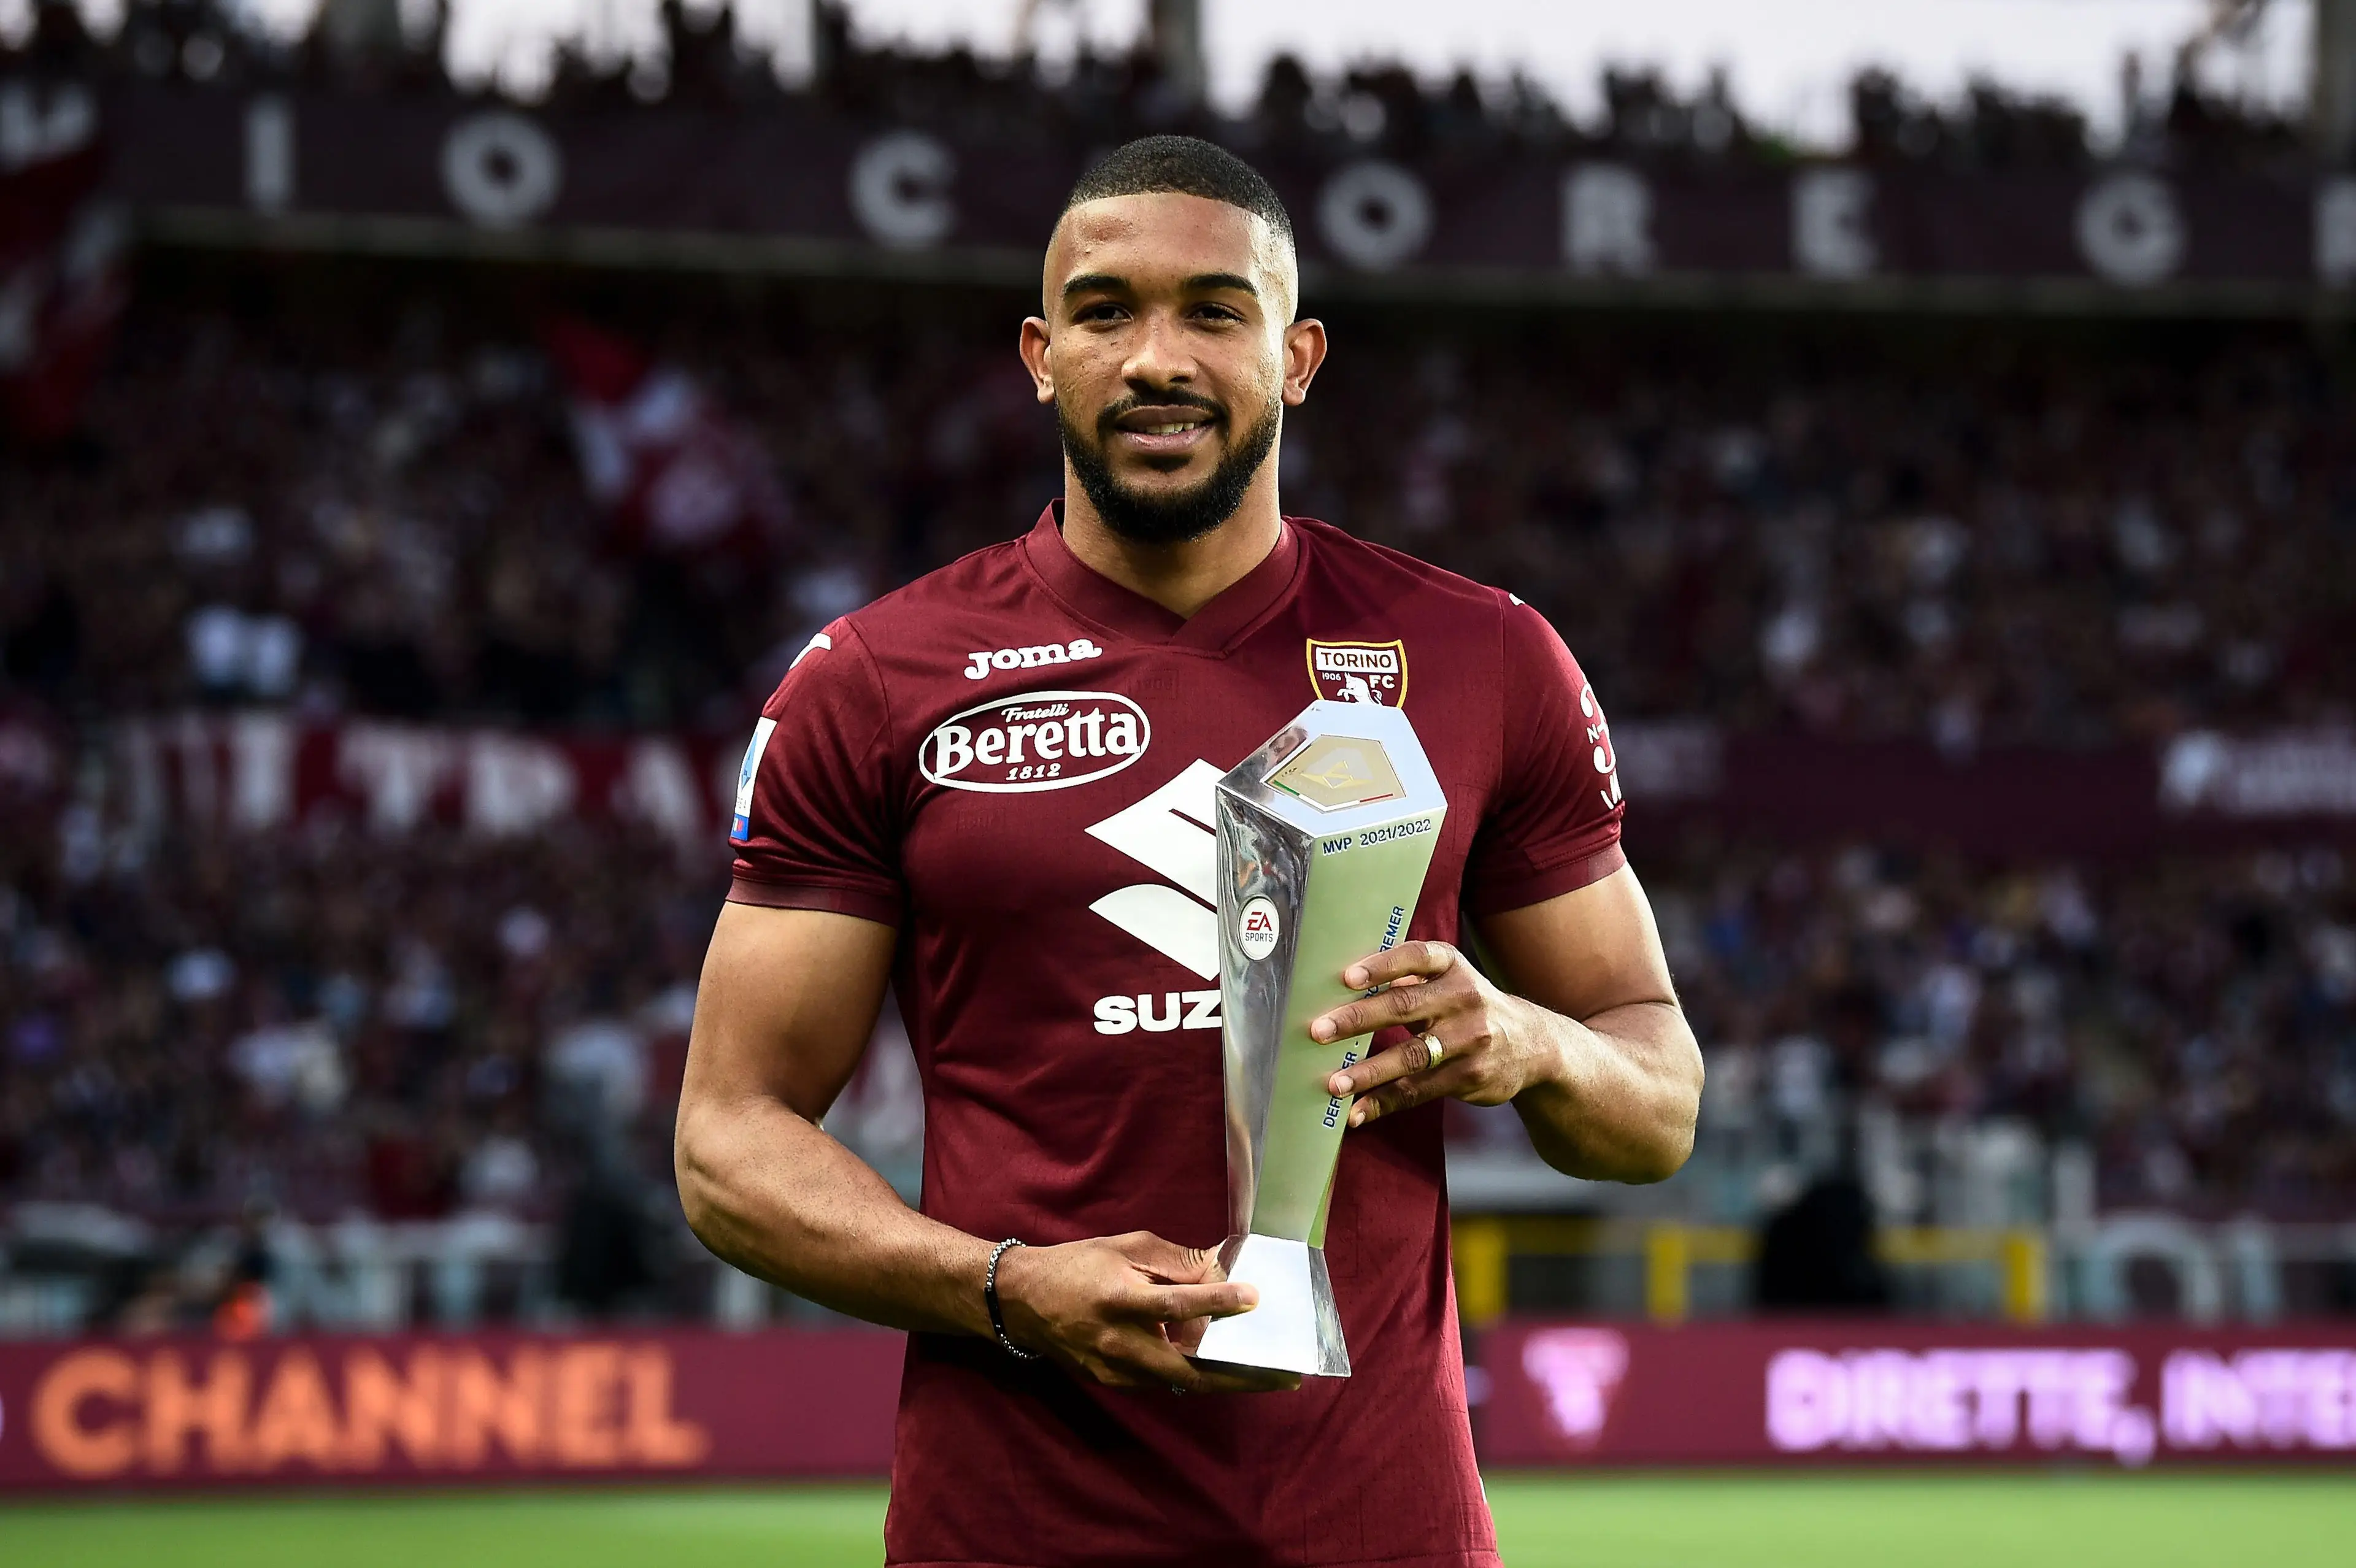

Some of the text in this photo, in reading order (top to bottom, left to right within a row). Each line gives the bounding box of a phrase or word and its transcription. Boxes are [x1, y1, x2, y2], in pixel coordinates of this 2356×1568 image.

[963, 638, 1103, 680] Joma
[1320, 652, 1392, 668] TORINO
[1322, 672, 1395, 689] 1906 FC
[1001, 703, 1069, 723] Fratelli
[933, 707, 1141, 779] Beretta
[1006, 764, 1061, 781] 1812
[1323, 819, 1431, 855] MVP 2021/2022
[1245, 932, 1273, 942] SPORTS
[1247, 912, 1272, 931] EA
[1379, 906, 1404, 953] REMER
[1093, 990, 1222, 1035] SUZ
[1323, 1051, 1358, 1128] DEFER
[31, 1346, 709, 1476] CHANNEL
